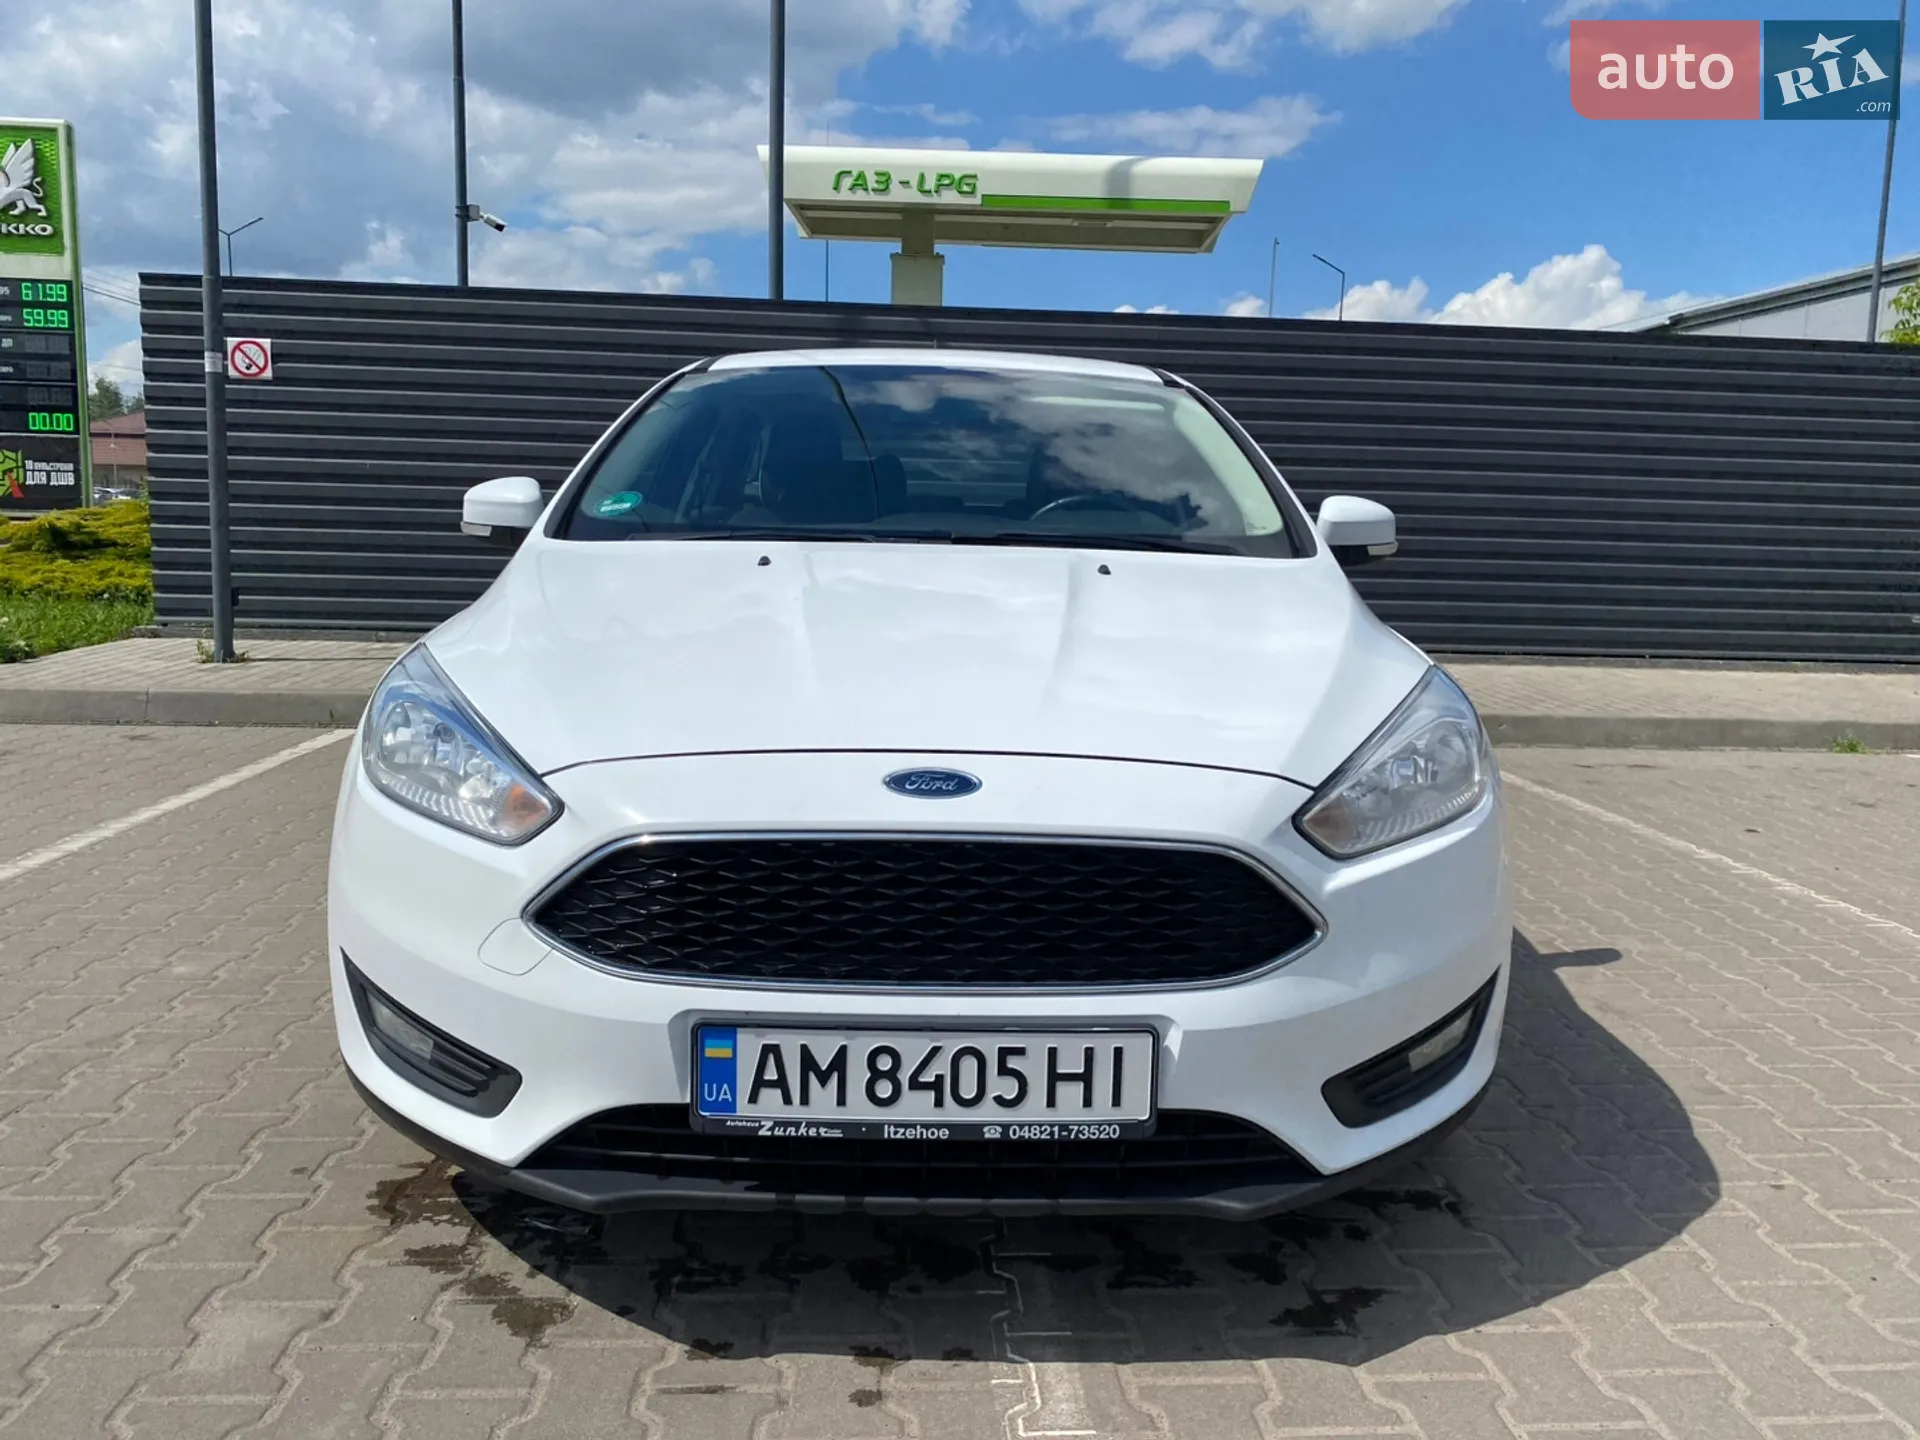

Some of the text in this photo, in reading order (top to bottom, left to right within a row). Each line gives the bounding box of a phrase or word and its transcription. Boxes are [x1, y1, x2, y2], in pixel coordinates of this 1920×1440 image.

[22, 282, 67, 302] 61.99
[23, 308, 68, 328] 59.99
[29, 412, 74, 431] 00.00
[904, 773, 959, 791] Ford
[746, 1042, 1124, 1109] AM 8405 HI
[703, 1083, 733, 1102] UA
[758, 1120, 843, 1138] Zunker
[883, 1124, 950, 1139] Itzehoe
[1009, 1124, 1121, 1140] 04821-73520
